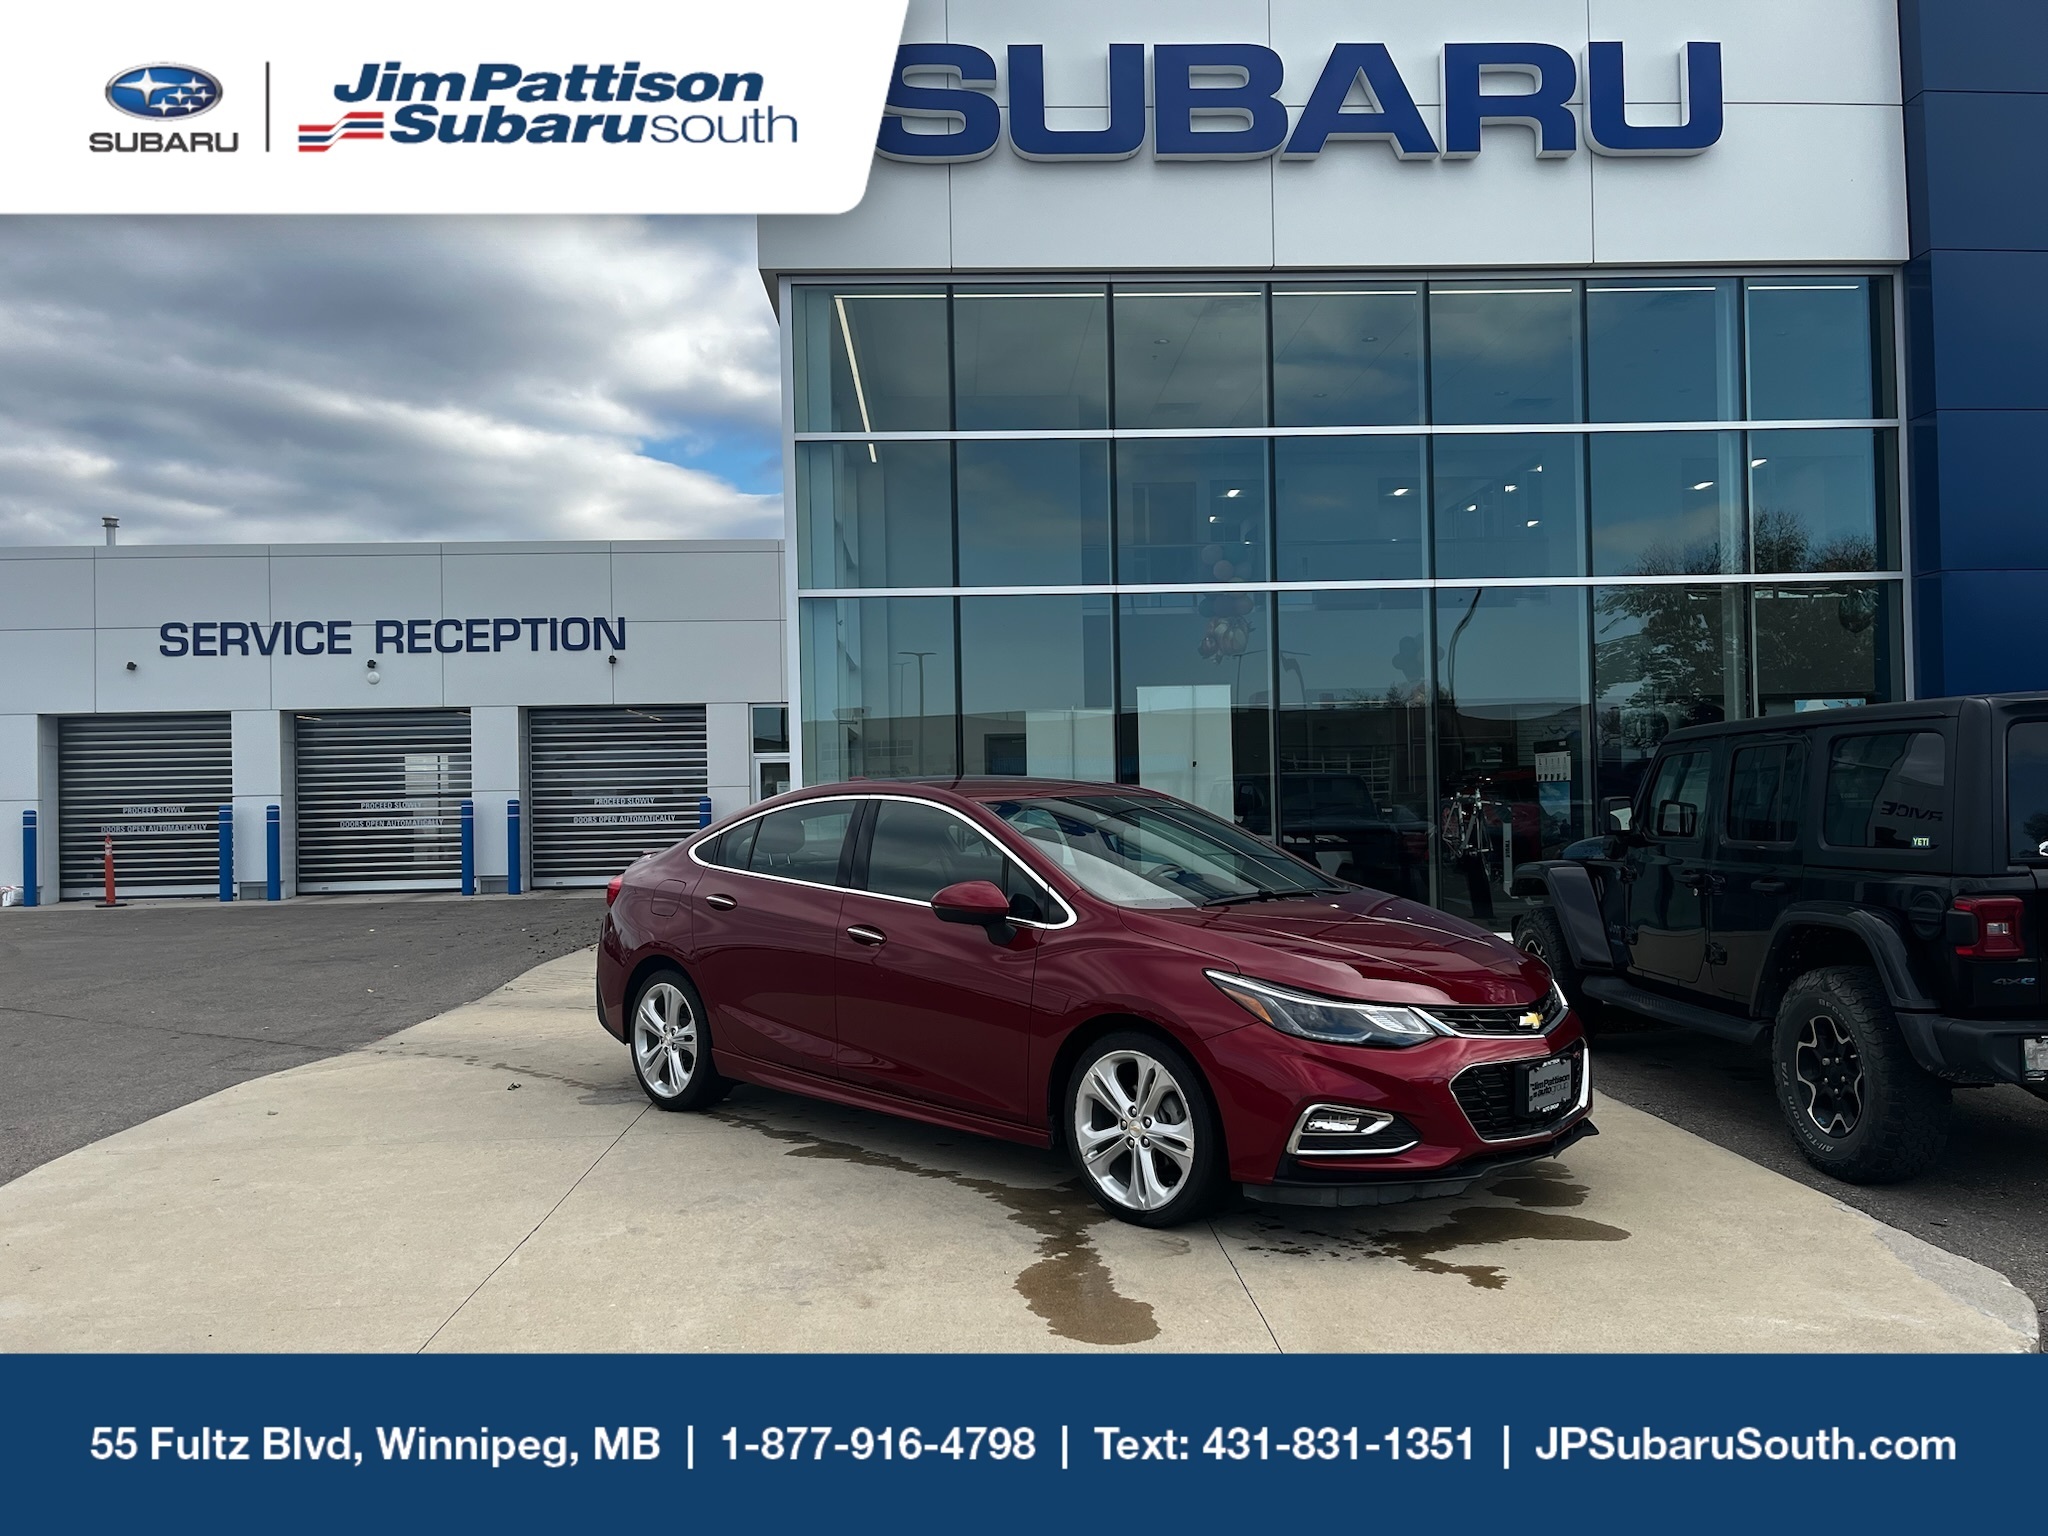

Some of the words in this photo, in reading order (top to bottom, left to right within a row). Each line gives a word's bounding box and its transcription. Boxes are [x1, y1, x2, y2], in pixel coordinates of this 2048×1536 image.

[877, 42, 1724, 160] SUBARU
[159, 621, 353, 657] SERVICE
[375, 617, 626, 654] RECEPTION
[593, 798, 625, 806] PROCEED
[627, 797, 655, 805] SLOWLY
[122, 807, 156, 815] PROCEED
[157, 806, 186, 814] SLOWLY
[339, 820, 364, 828] DOORS
[386, 819, 444, 827] AUTOMATICALLY
[573, 816, 597, 824] DOORS
[618, 814, 676, 823] AUTOMATICALLY
[100, 825, 126, 833] DOORS
[126, 825, 146, 833] OPEN
[148, 823, 208, 832] AUTOMATICALLY
[1913, 837, 1930, 847] YETI
